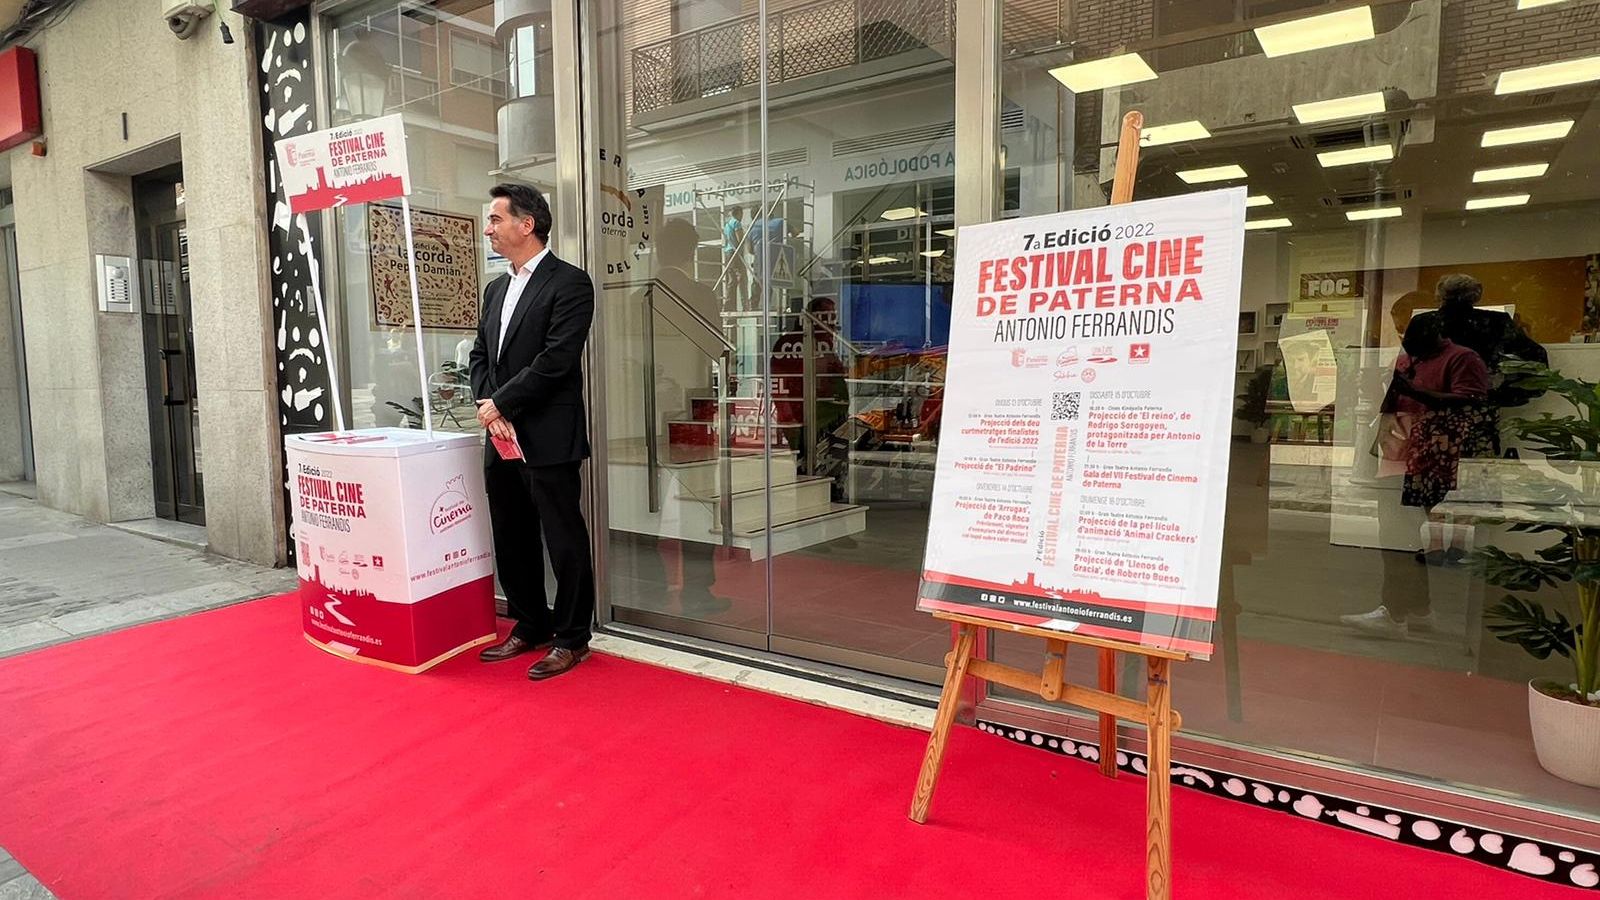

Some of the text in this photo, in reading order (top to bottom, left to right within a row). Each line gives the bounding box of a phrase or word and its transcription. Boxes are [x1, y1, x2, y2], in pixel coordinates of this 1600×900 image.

[328, 132, 386, 157] FESTIVAL CINE
[332, 148, 387, 167] DE PATERNA
[1044, 224, 1112, 249] Edició
[1115, 223, 1154, 240] 2022
[415, 250, 452, 264] corda
[390, 260, 420, 274] Pepn
[606, 260, 631, 274] DEL
[977, 236, 1204, 294] FESTIVAL CINE
[1308, 279, 1350, 296] FOC
[976, 278, 1204, 317] DE PATERNA
[994, 308, 1175, 342] ANTONIO FERRANDIS
[980, 420, 1010, 428] Projecció
[1088, 412, 1126, 422] Projecció
[961, 428, 1006, 436] curtmetratges
[1088, 422, 1168, 432] Rodrigo Sorogoyen,
[1087, 431, 1148, 440] protagonitzada
[1166, 432, 1201, 440] Antonio
[954, 462, 984, 470] Projecció
[1083, 470, 1100, 478] Gala
[1124, 472, 1154, 480] Festival
[1167, 474, 1198, 483] Cinema
[298, 475, 364, 504] FESTIVAL CINE
[1043, 426, 1068, 567] FESTIVAL CINE DE PATERNA
[300, 496, 366, 518] DE PATERNA
[955, 501, 986, 511] Projecció
[434, 504, 472, 528] Cinema
[1012, 514, 1030, 522] Roca
[1078, 516, 1116, 527] Projecció
[1078, 526, 1120, 536] d'animació
[1074, 554, 1112, 566] Projecció
[1114, 558, 1124, 566] de
[1158, 562, 1170, 572] de
[1105, 568, 1114, 576] de
[1118, 568, 1150, 580] Roberto
[1152, 573, 1180, 583] Bueso
[1013, 598, 1133, 623] www.festivalantonioferrandis.es
